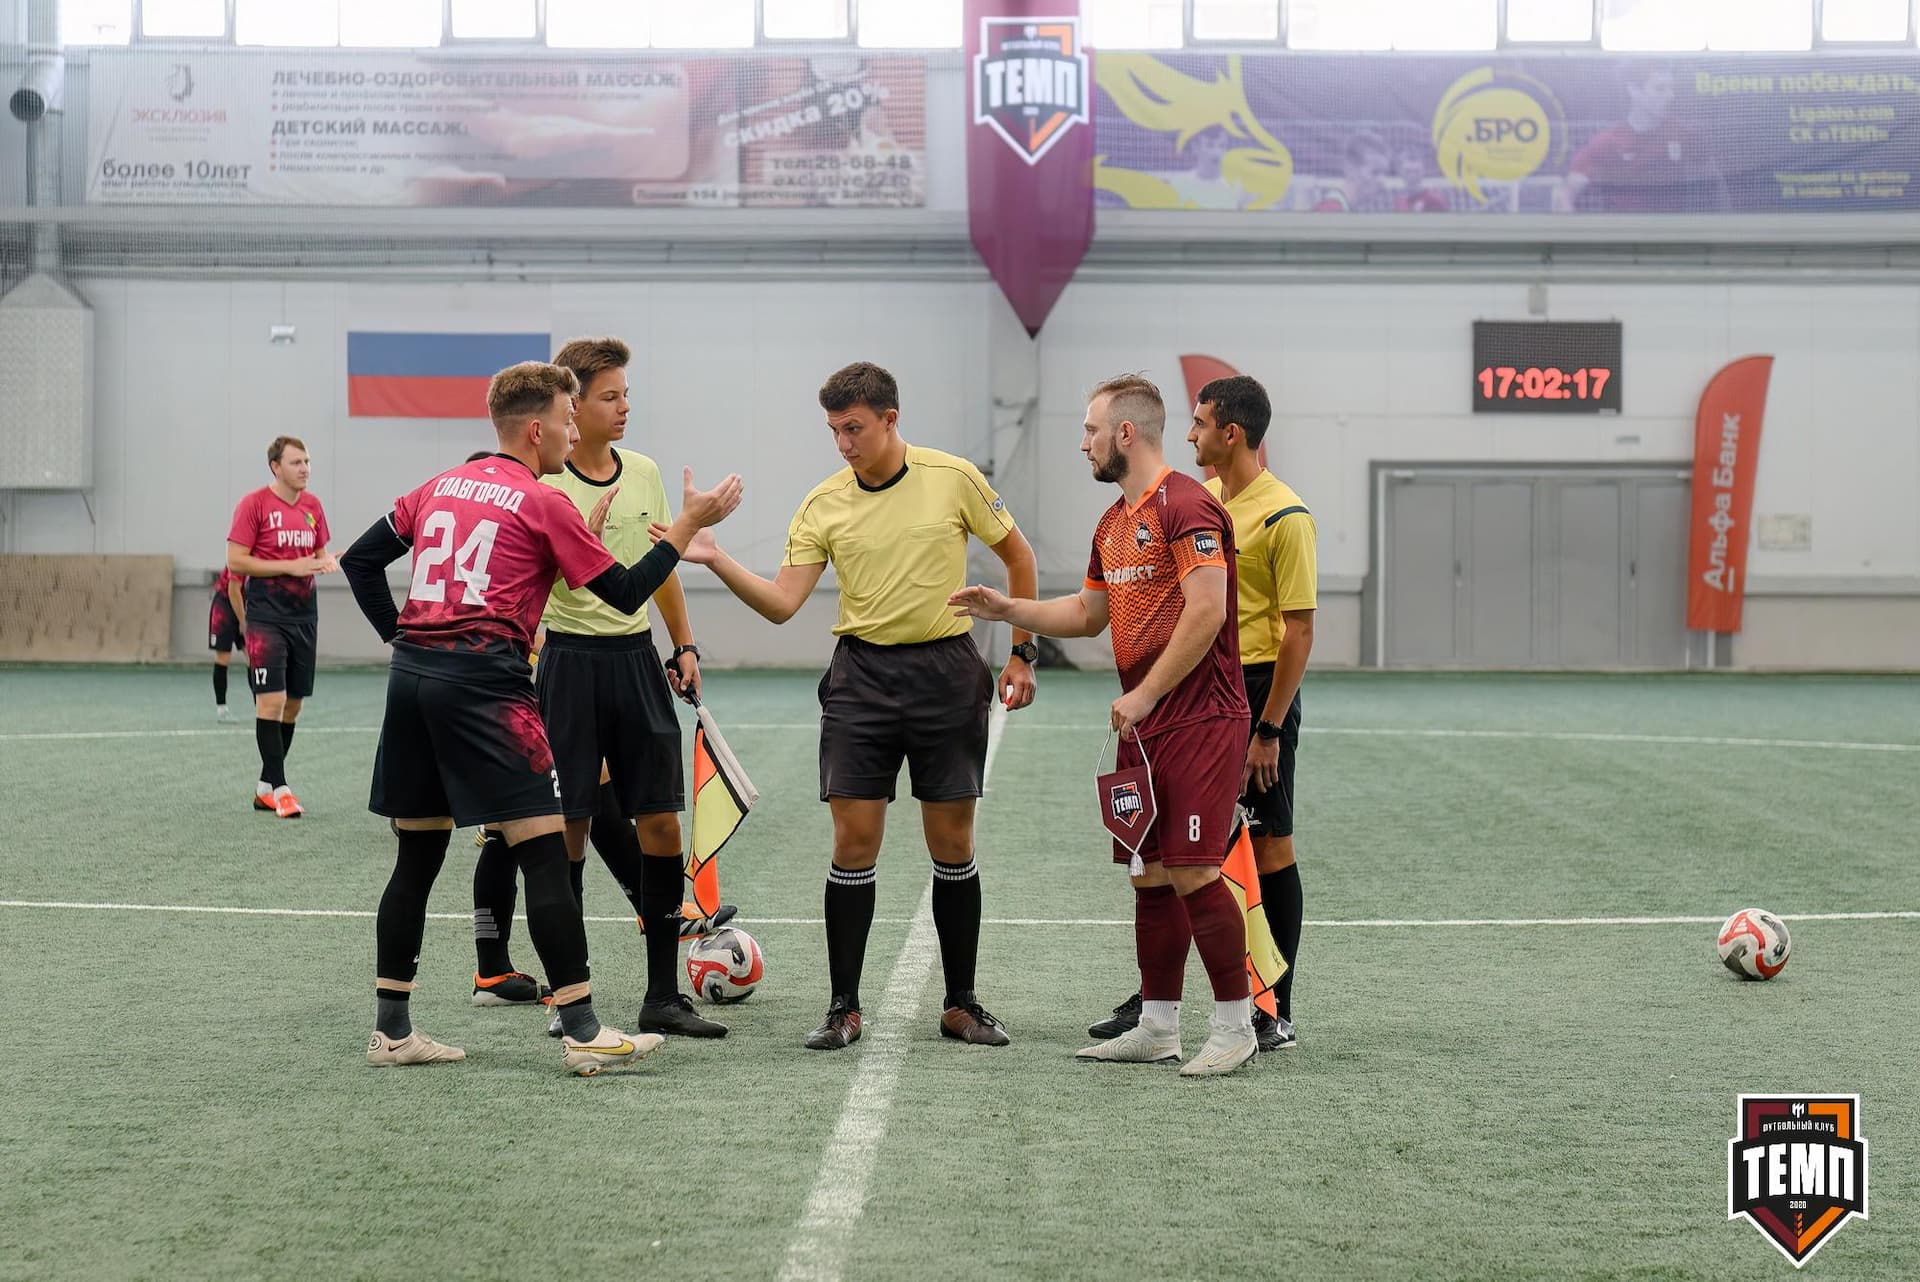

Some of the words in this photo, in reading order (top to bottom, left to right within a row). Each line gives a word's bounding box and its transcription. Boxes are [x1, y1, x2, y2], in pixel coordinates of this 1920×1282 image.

[272, 70, 580, 88] ЛЕЧЕБНО-ОЗДОРОВИТЕЛЬНЫЙ
[984, 58, 1078, 108] ТЕМП
[1695, 71, 1774, 95] Время
[271, 118, 366, 137] ДЕТСКИЙ
[722, 105, 822, 148] скидка
[827, 80, 890, 116] 20%
[1465, 117, 1538, 143] .БРО
[103, 158, 175, 179] более
[184, 160, 252, 179] 10лет
[1478, 367, 1611, 400] 17:02:17
[1712, 412, 1741, 488] Банк
[433, 477, 526, 514] СЛАВГОРОД
[269, 510, 283, 529] 17
[1703, 493, 1735, 591] Альфа
[409, 510, 499, 606] 24
[255, 667, 268, 685] 17
[1114, 795, 1140, 814] ТЕМП
[1188, 814, 1201, 842] 8
